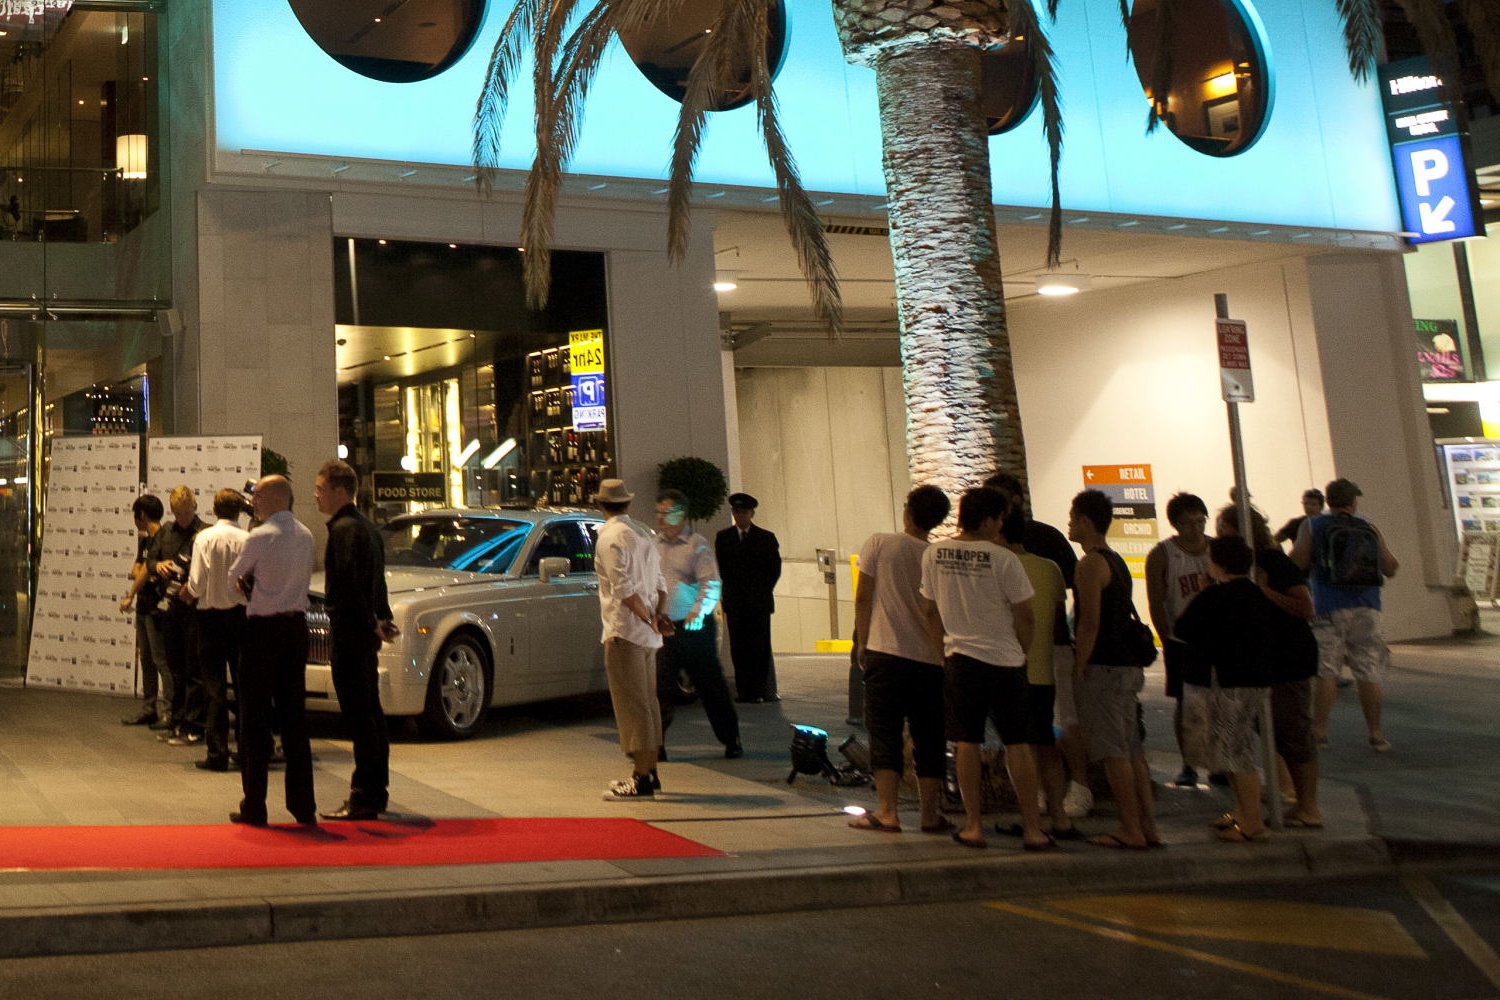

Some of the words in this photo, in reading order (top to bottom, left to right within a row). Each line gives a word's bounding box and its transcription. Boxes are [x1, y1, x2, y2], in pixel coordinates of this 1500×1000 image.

[1410, 149, 1449, 196] P
[1119, 467, 1147, 480] RETAIL
[378, 487, 407, 498] FOOD
[409, 487, 442, 498] STORE
[1123, 487, 1149, 500] HOTEL
